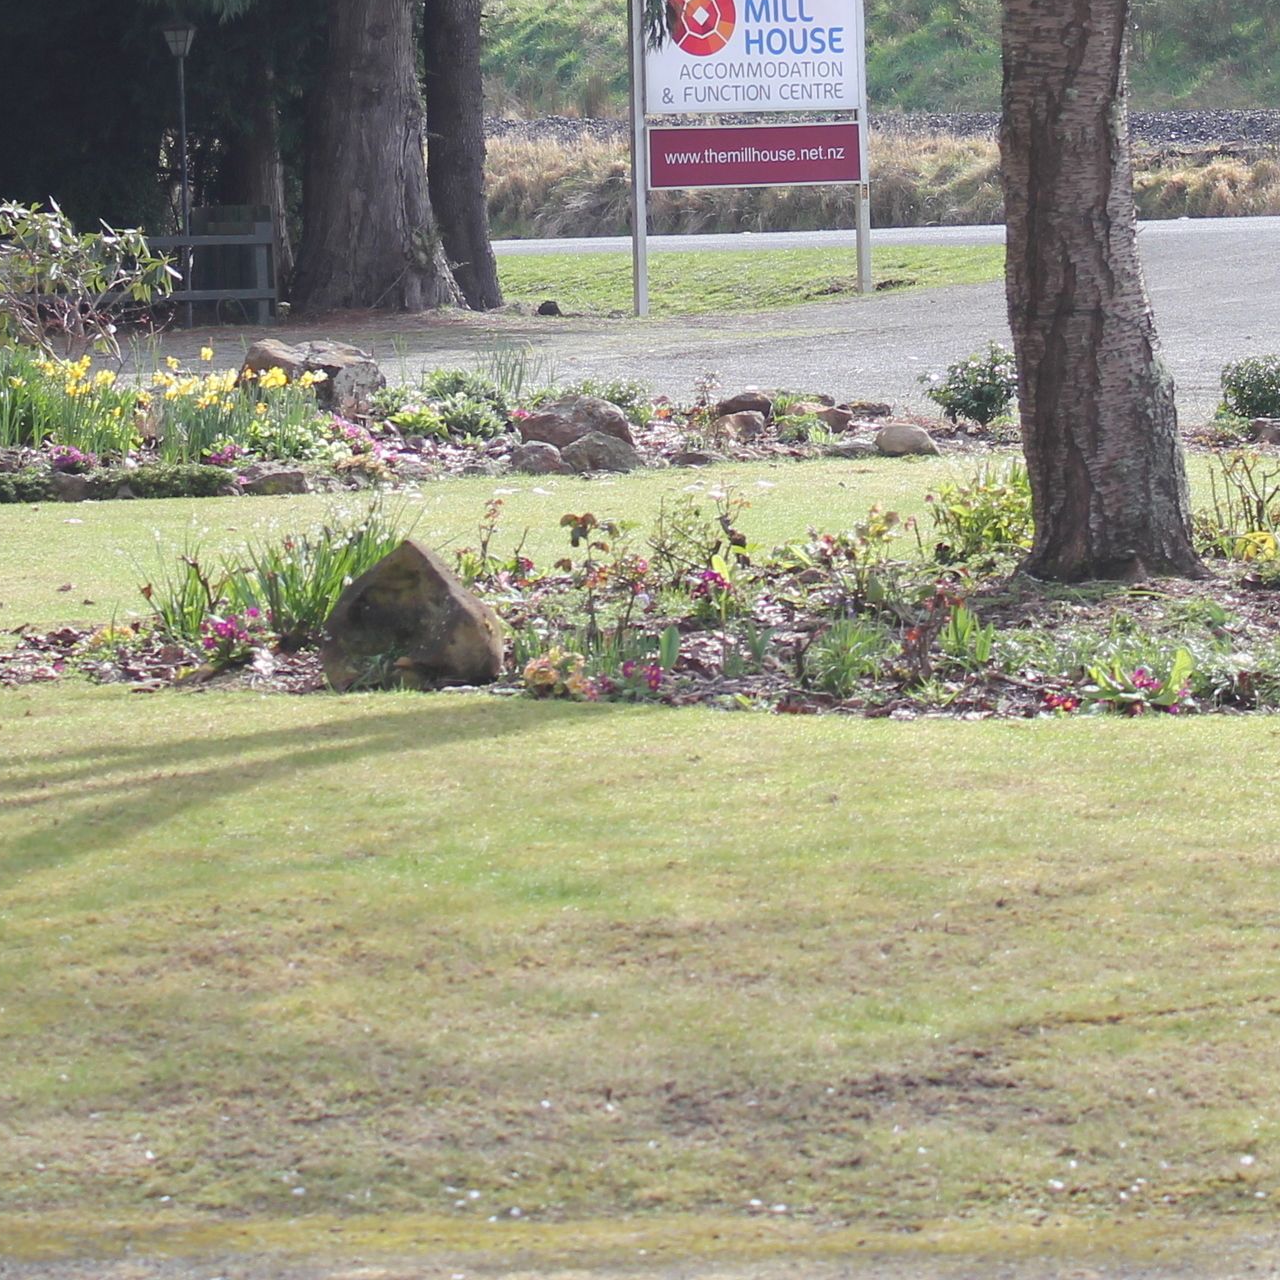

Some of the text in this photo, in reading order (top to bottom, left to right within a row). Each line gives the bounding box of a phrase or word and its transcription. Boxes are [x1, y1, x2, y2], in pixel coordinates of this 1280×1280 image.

[745, 27, 845, 56] HOUSE
[679, 61, 843, 81] ACCOMMODATION
[662, 82, 844, 105] & FUNCTION CENTRE
[664, 145, 845, 165] www.themillhouse.net.nz
